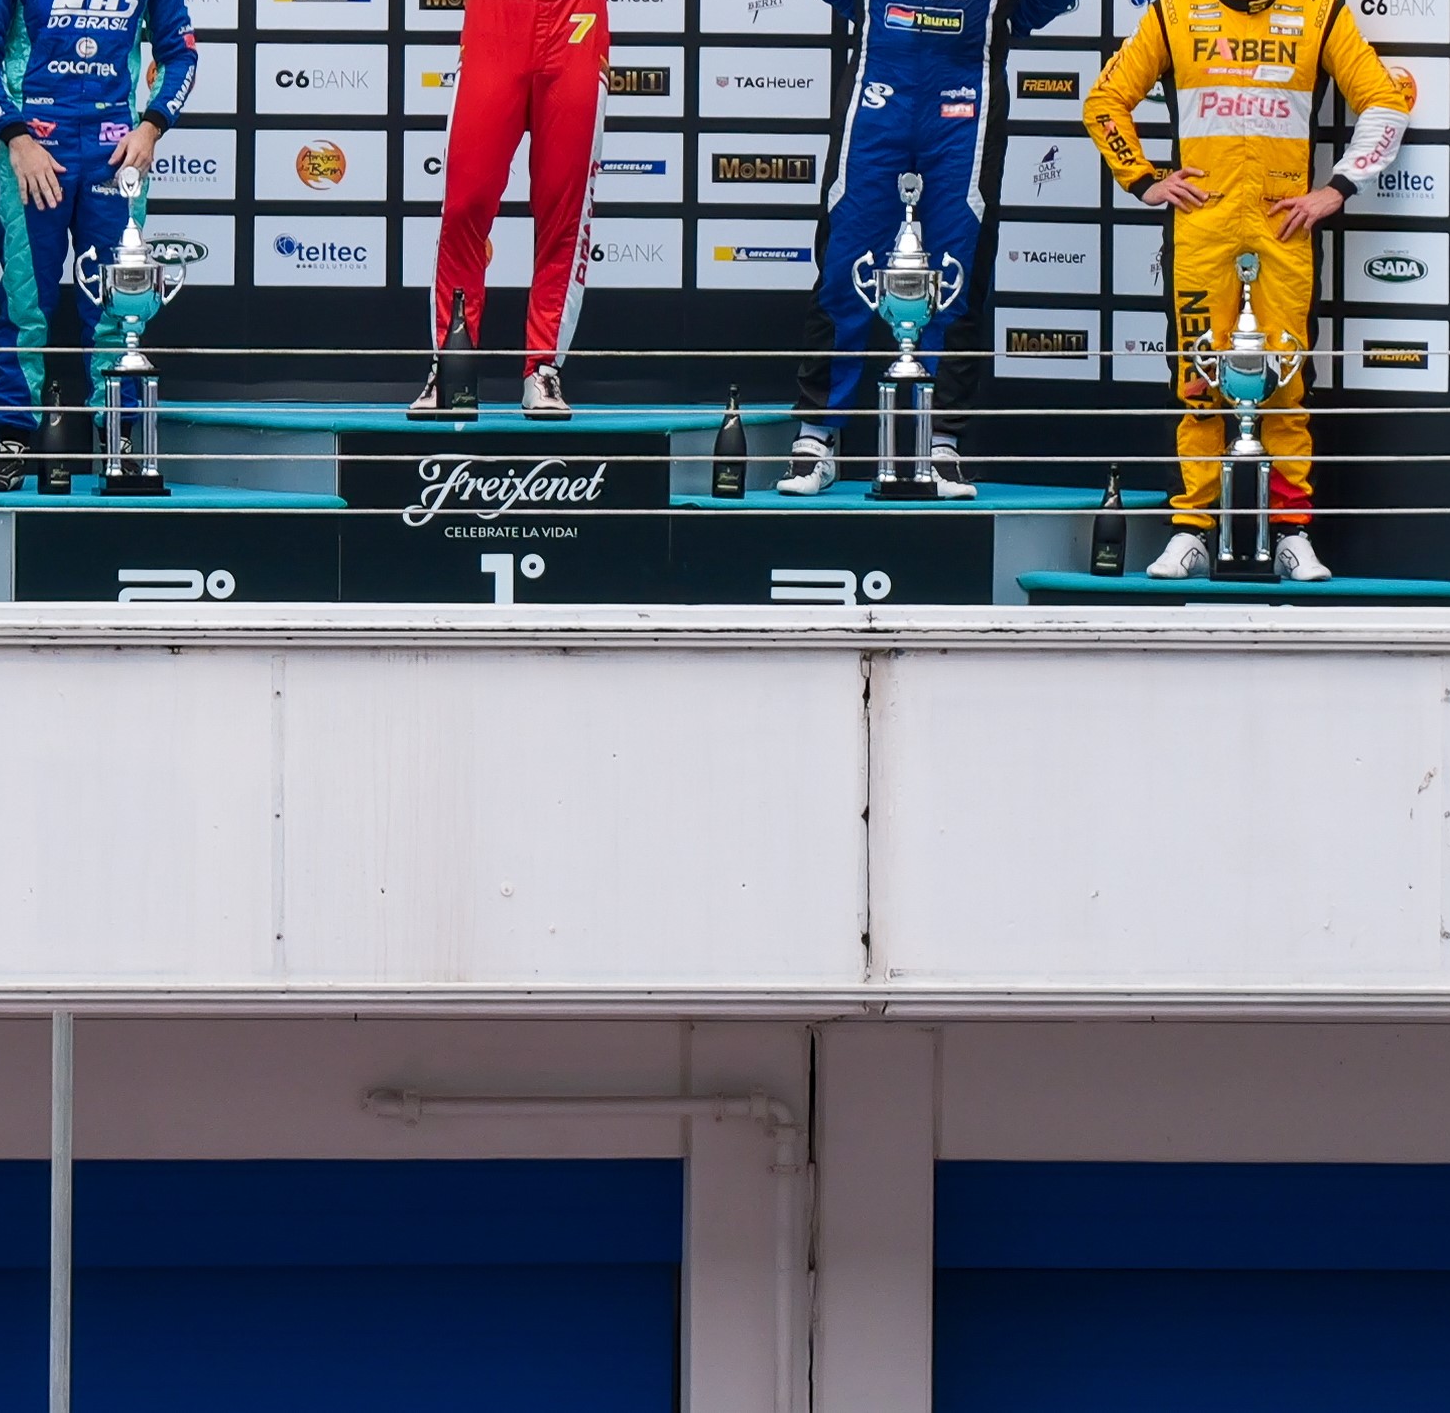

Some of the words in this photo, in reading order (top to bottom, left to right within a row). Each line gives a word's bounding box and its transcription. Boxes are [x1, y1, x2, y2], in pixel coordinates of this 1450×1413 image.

[47, 16, 71, 29] DO
[75, 16, 129, 32] BRASIL
[567, 13, 597, 44] 7
[914, 12, 960, 28] Taurus
[1192, 37, 1297, 65] FARBEN
[1023, 80, 1073, 92] FREMAX
[1199, 92, 1291, 120] Patrus
[719, 158, 783, 178] Mobil
[1378, 172, 1433, 191] teltec
[297, 245, 366, 262] teltec
[749, 249, 798, 258] MICHELIN
[1372, 261, 1420, 277] SADA
[402, 454, 608, 527] Freixenet
[445, 527, 519, 537] CELEBRATE
[523, 527, 539, 537] LA
[541, 527, 577, 537] VIDA!
